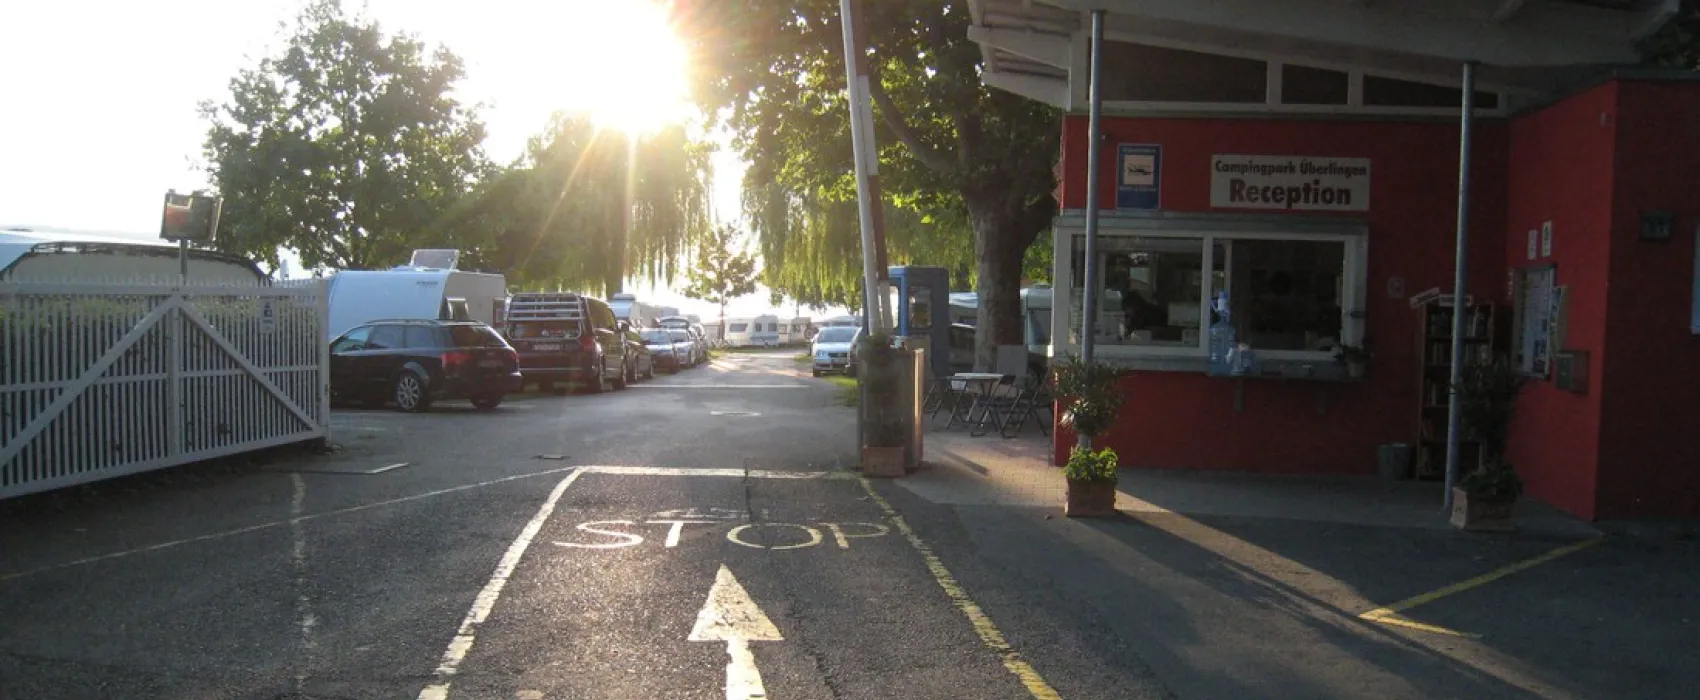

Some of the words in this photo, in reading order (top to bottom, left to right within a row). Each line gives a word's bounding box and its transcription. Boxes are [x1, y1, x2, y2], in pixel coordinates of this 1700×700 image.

[1215, 160, 1297, 176] Campingpark
[1300, 158, 1367, 177] Überlingen
[1229, 178, 1352, 208] Reception
[553, 520, 890, 550] STOP
